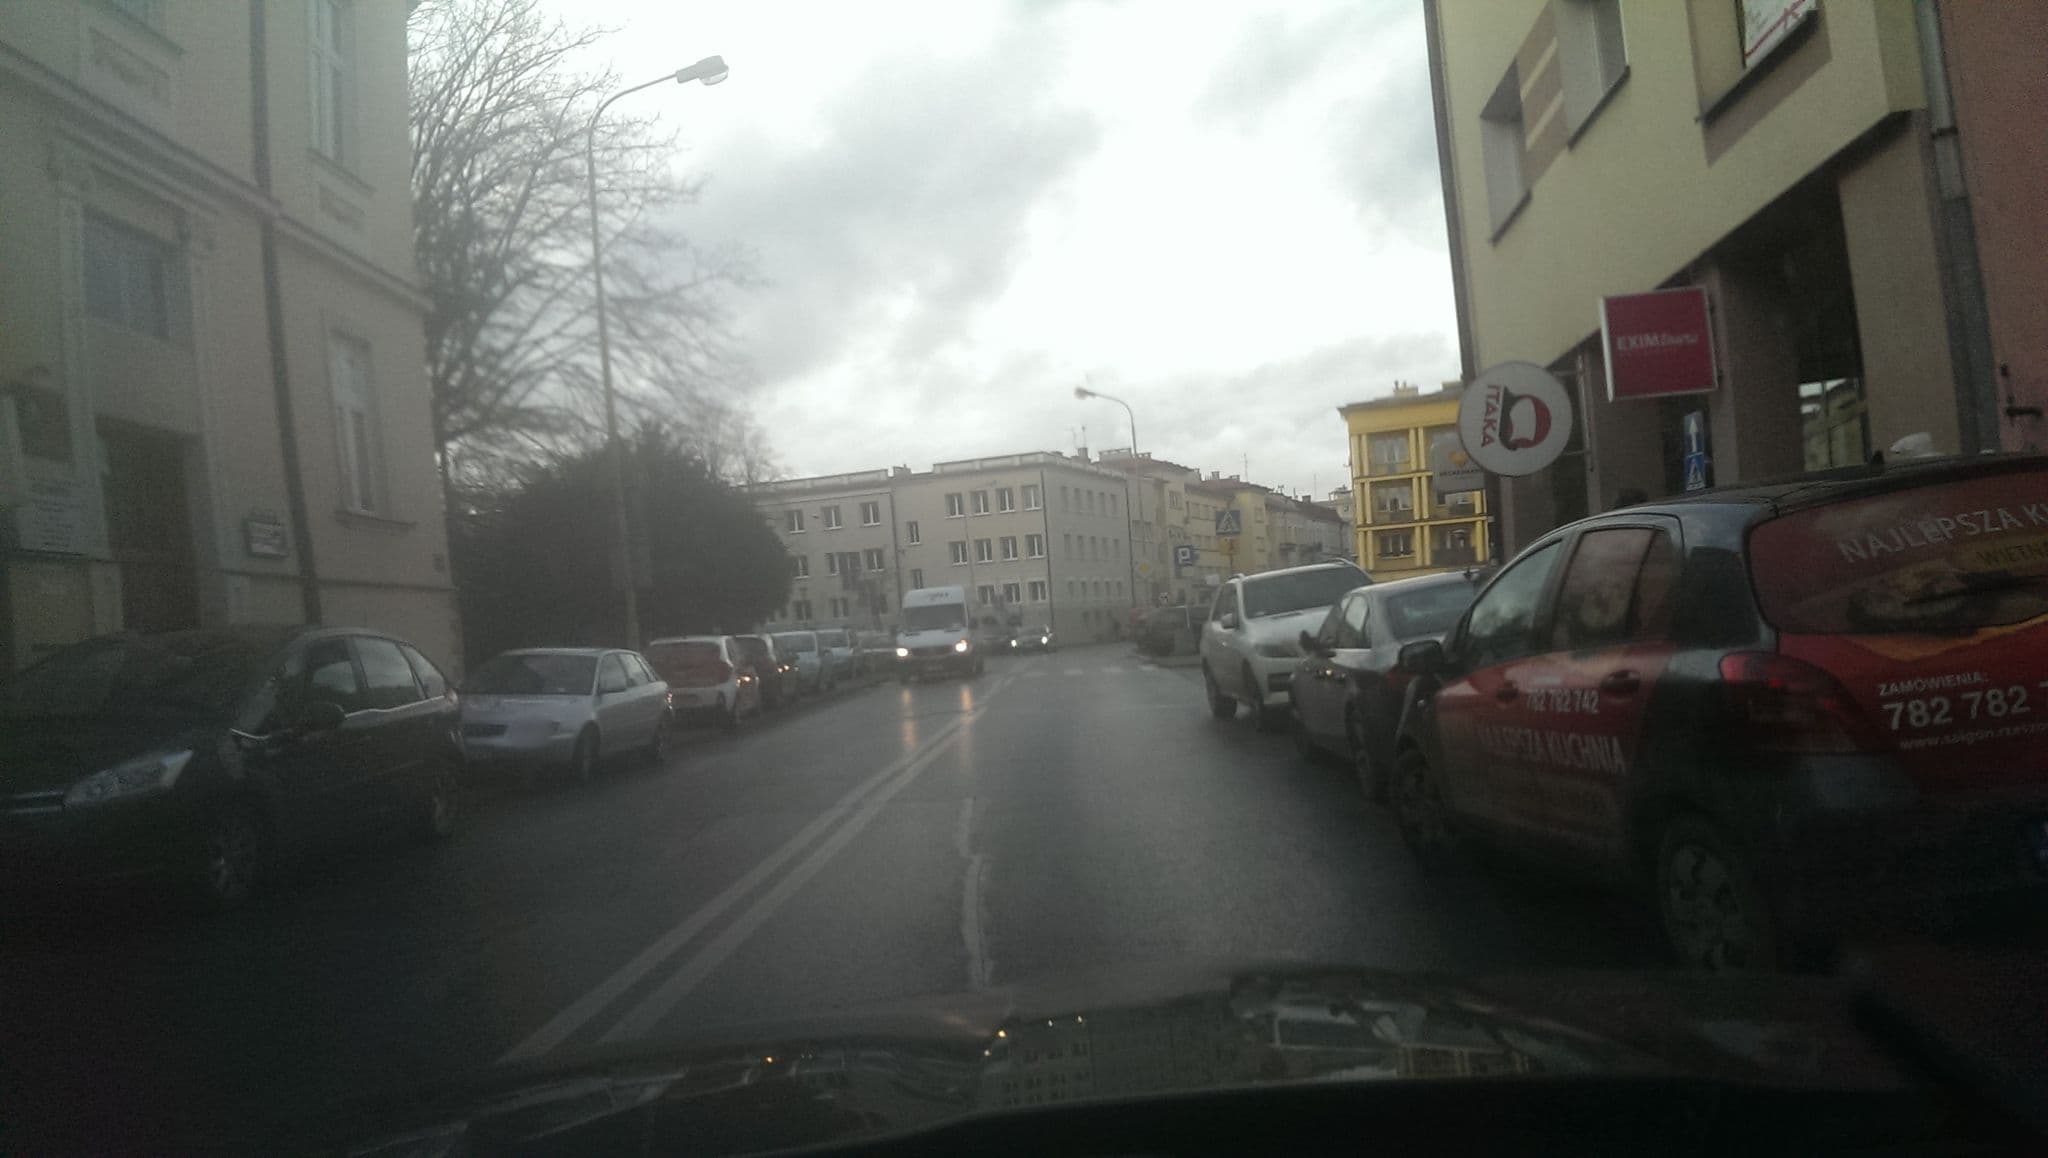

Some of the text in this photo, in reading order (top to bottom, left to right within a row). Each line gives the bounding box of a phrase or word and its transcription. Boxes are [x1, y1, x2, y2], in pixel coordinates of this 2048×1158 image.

[1481, 384, 1500, 448] ITAKA
[1177, 547, 1191, 565] P
[1838, 508, 2023, 563] NAJLEPSZA
[1882, 696, 1953, 731] 782
[1960, 685, 2031, 720] 782
[1545, 730, 1627, 776] KUCHNIA
